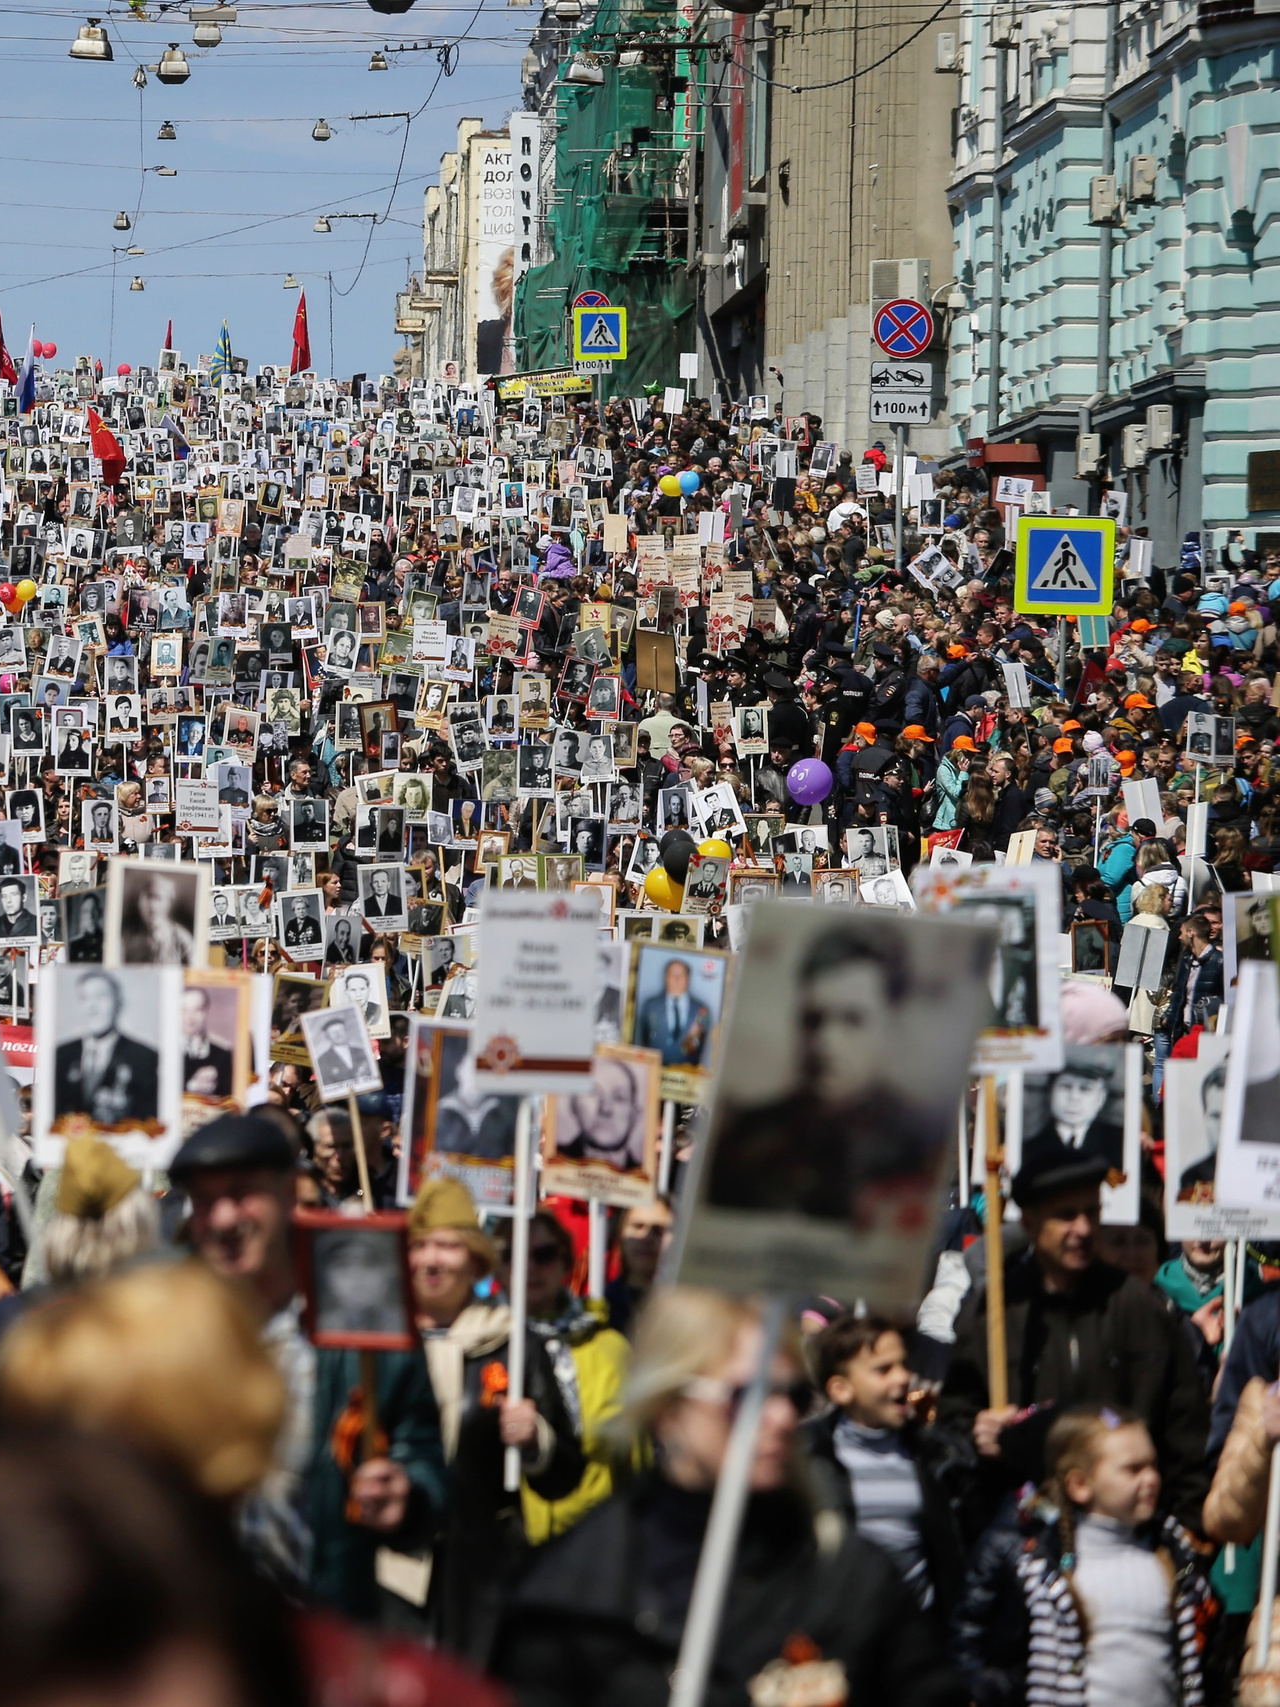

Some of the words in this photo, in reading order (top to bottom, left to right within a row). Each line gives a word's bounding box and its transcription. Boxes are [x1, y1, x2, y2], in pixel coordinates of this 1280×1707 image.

[484, 188, 514, 200] ВОЗ
[483, 205, 515, 218] ТОЛ
[883, 402, 918, 414] 100м
